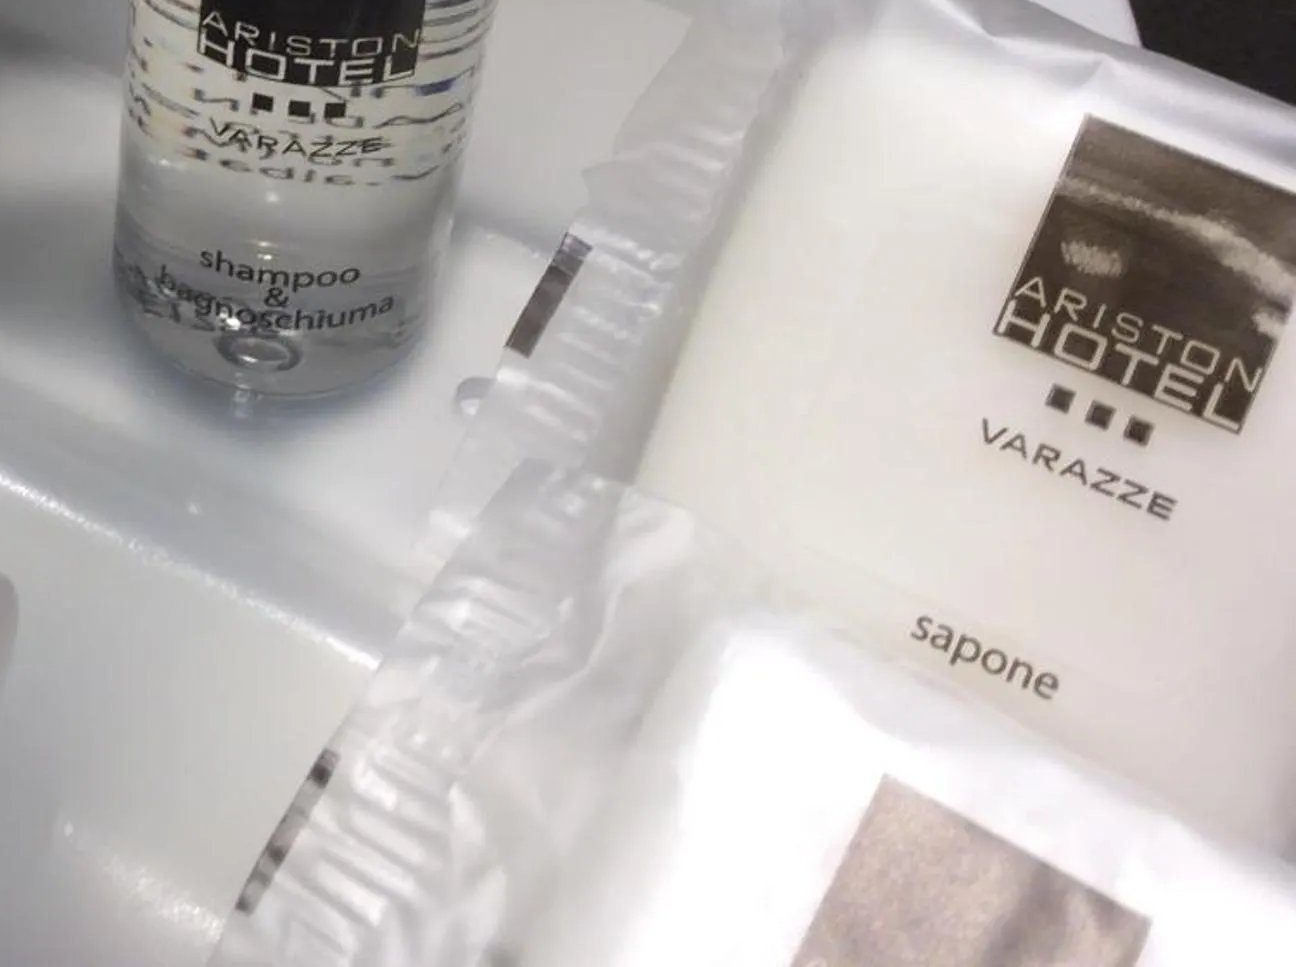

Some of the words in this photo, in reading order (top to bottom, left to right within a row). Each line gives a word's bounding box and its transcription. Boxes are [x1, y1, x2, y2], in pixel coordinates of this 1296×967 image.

[197, 32, 416, 86] HOTEL
[201, 10, 422, 59] ARISTON
[209, 116, 387, 158] VARAZZE
[156, 262, 394, 330] bagnoschiuma
[199, 247, 362, 292] shampoo
[263, 286, 290, 309] &
[1015, 275, 1264, 394] ARISTON
[994, 299, 1242, 434] HOTEL
[980, 417, 1178, 521] VARAZZE
[910, 612, 1061, 700] sapone
